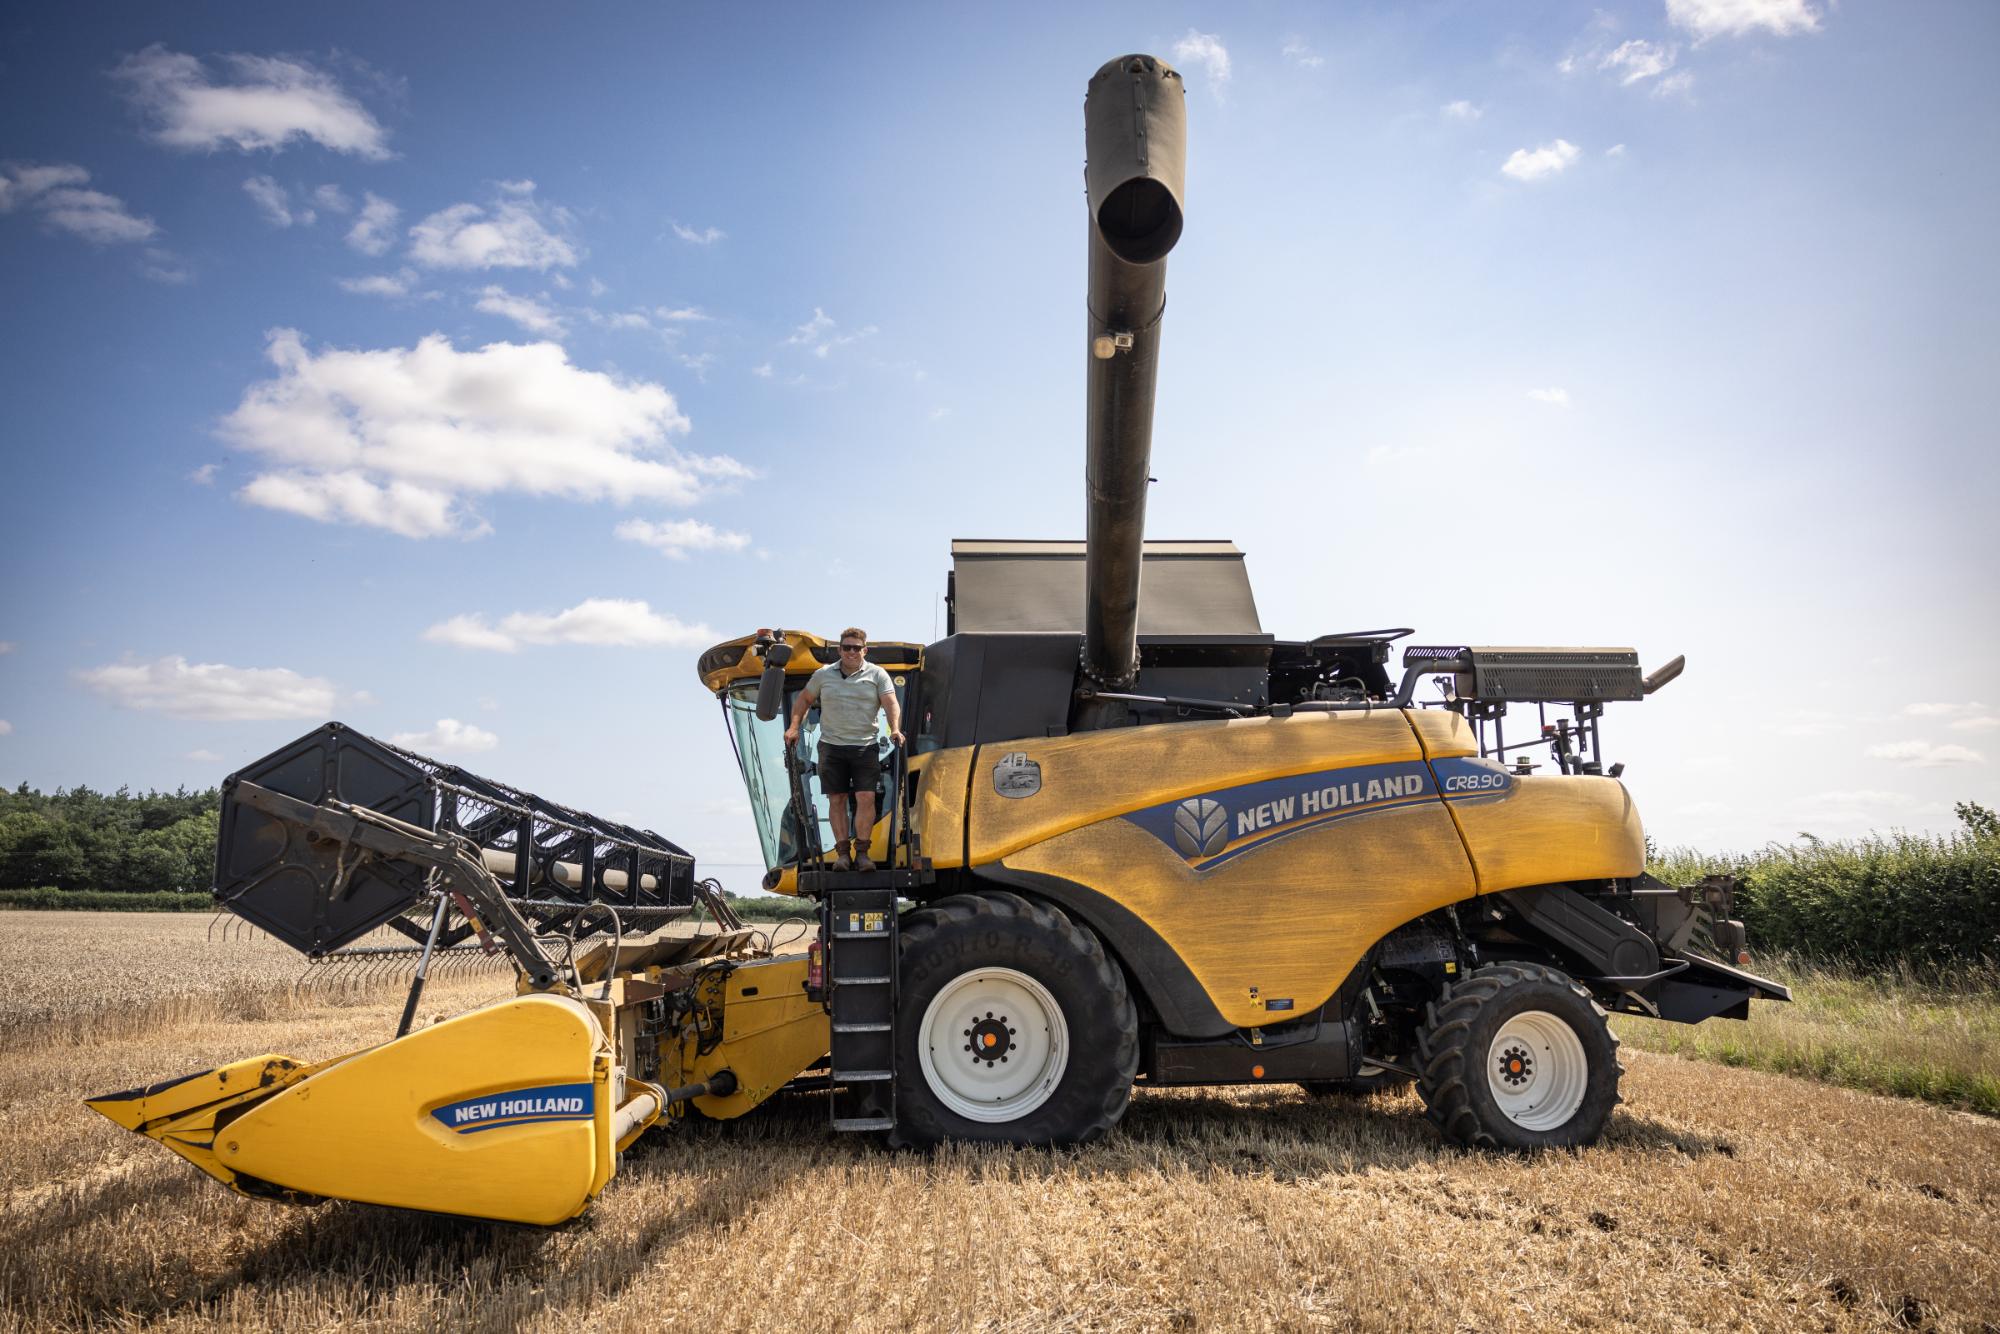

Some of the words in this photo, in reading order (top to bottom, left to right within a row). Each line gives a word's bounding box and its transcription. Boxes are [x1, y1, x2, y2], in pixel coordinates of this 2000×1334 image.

[1445, 773, 1505, 792] CR8.90
[1237, 797, 1297, 836] NEW
[1302, 774, 1423, 816] HOLLAND
[455, 1102, 497, 1123] NEW
[501, 1097, 584, 1116] HOLLAND
